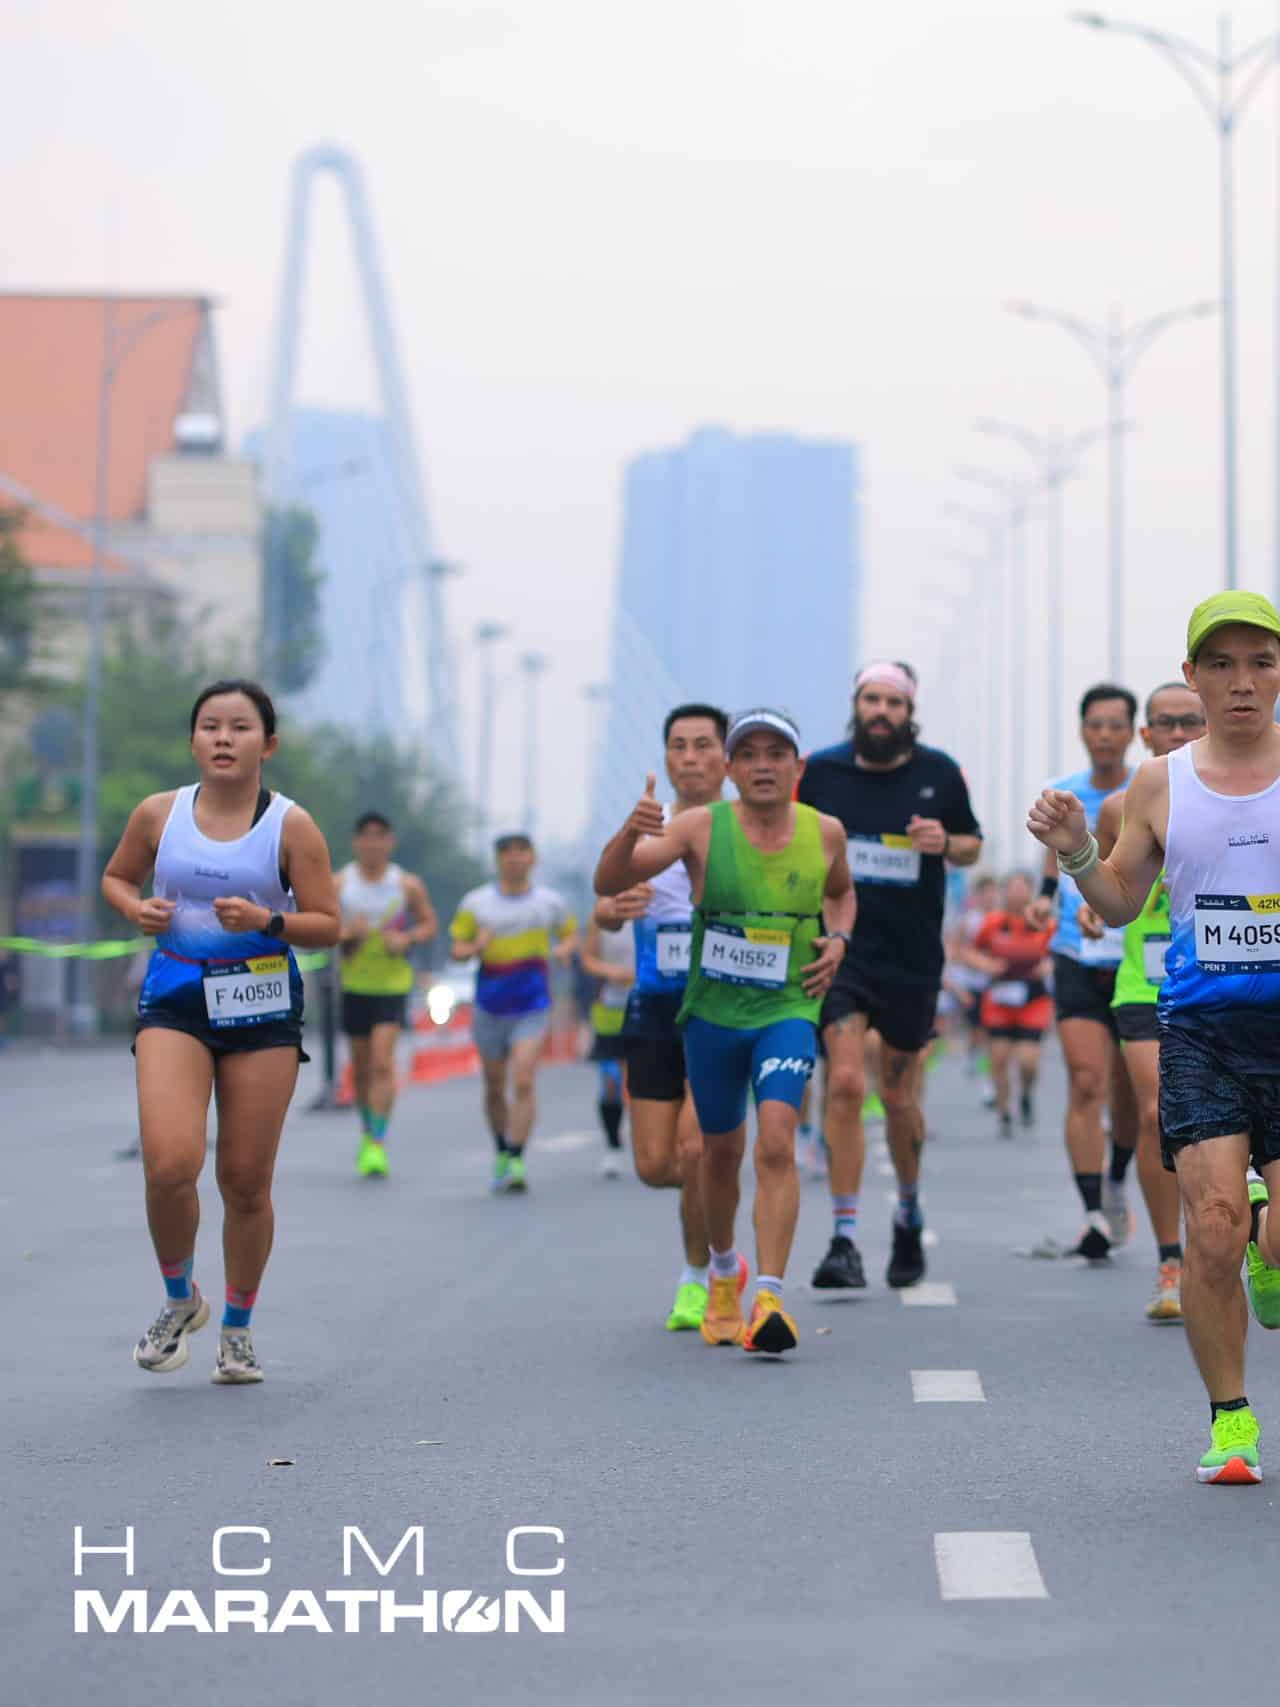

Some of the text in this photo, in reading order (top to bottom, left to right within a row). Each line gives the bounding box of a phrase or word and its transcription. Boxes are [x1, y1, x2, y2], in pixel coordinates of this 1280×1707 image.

[1204, 924, 1221, 944] M
[667, 944, 681, 960] M
[711, 943, 777, 968] M 41552
[1204, 962, 1221, 972] PEN
[216, 981, 283, 1005] F 40530
